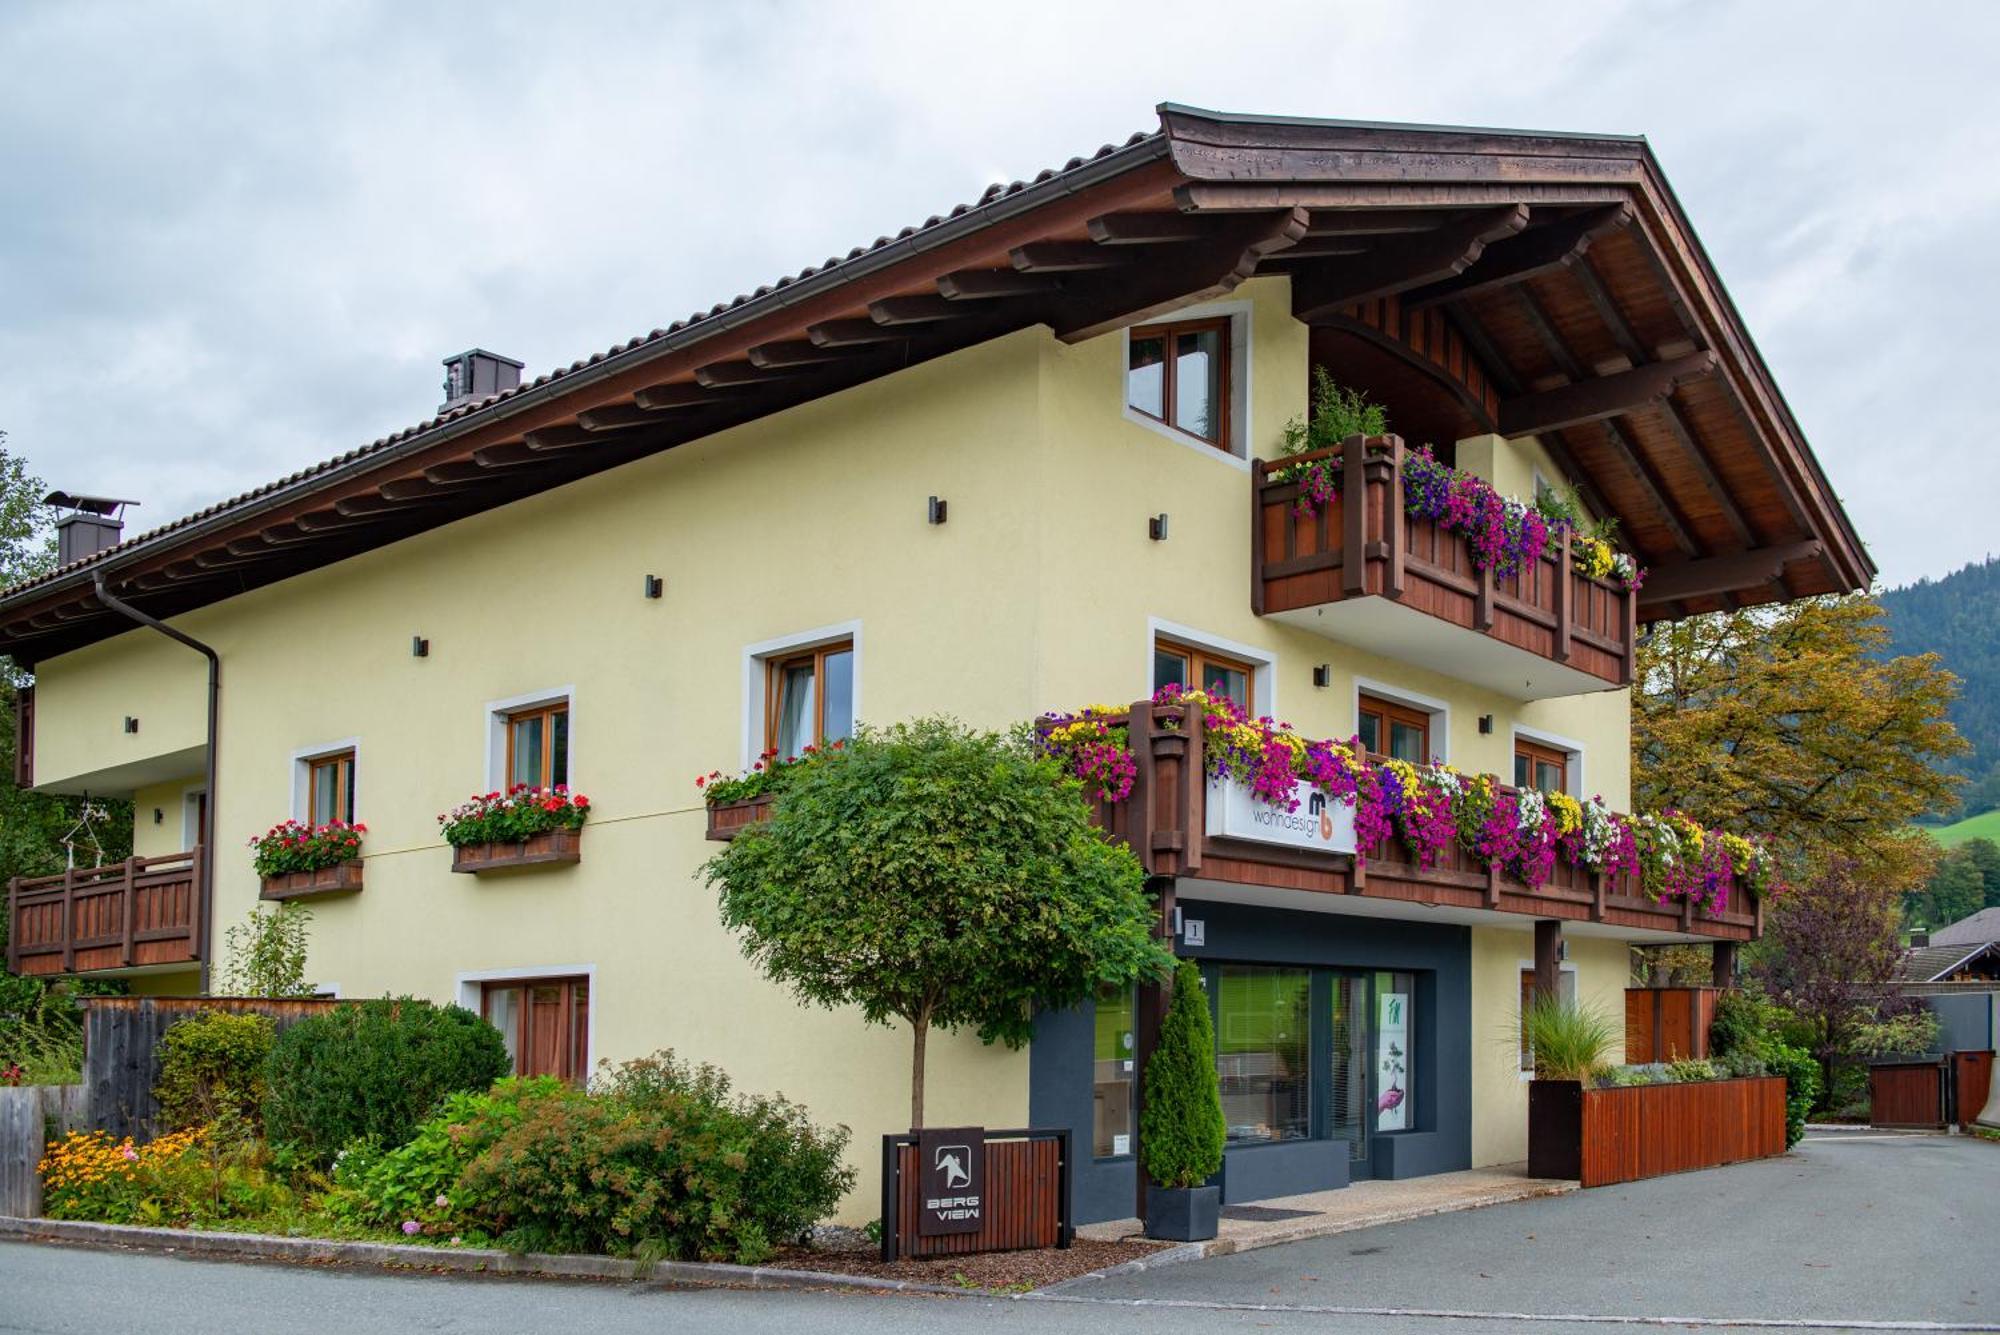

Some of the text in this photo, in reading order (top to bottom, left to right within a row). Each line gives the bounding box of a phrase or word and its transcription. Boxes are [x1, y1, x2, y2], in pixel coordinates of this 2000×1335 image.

[1192, 924, 1197, 937] 1
[927, 1196, 980, 1209] BERG
[936, 1208, 980, 1221] VIEW
